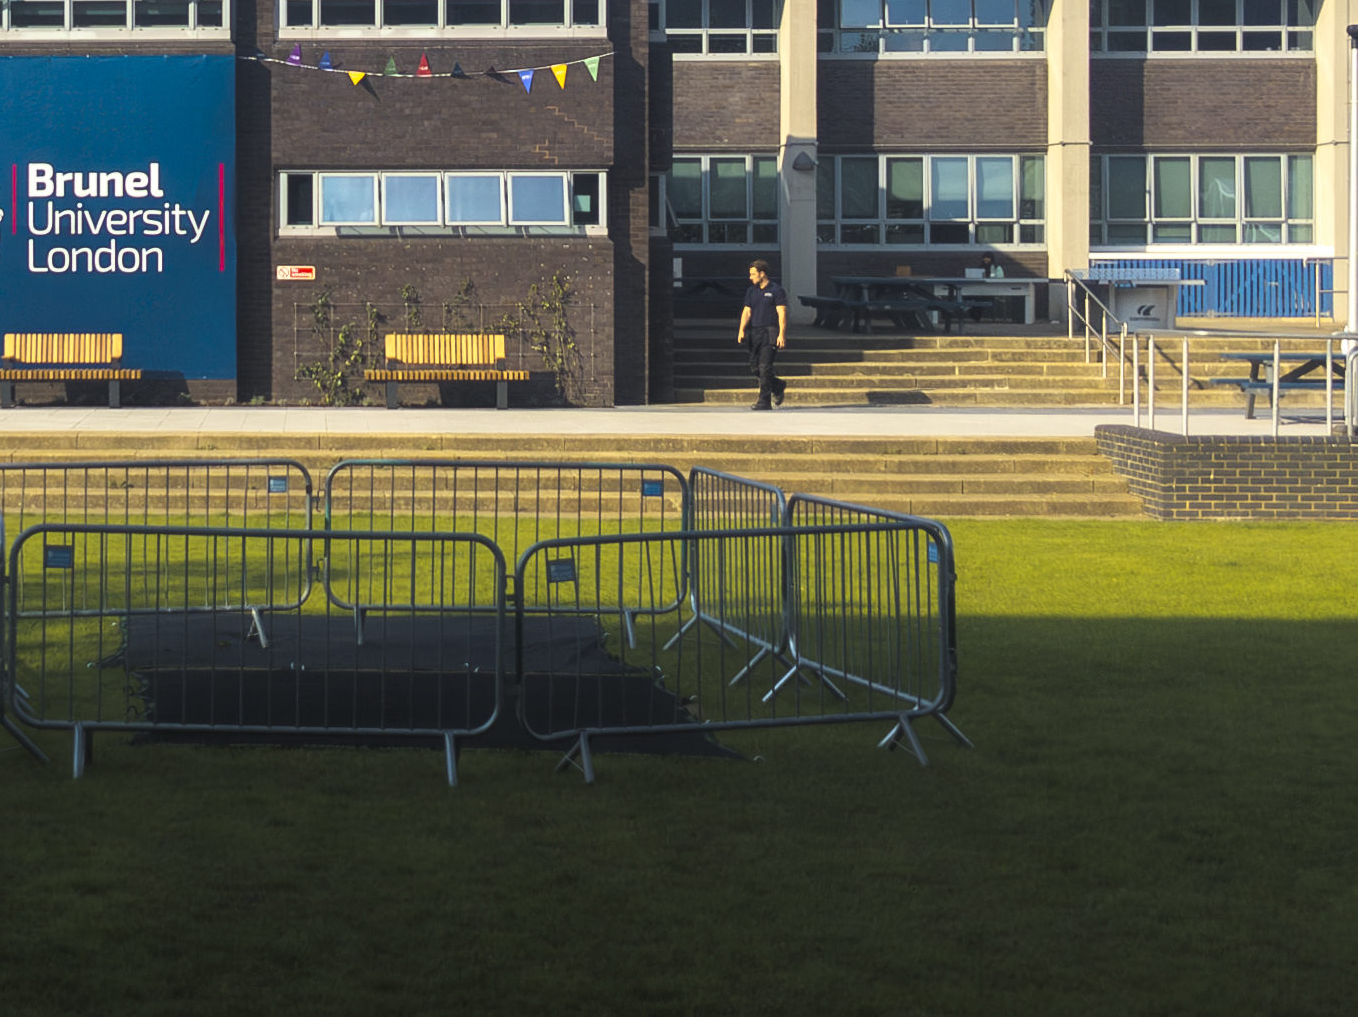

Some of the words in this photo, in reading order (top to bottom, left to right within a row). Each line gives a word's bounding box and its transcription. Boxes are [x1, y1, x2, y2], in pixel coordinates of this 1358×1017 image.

[28, 162, 164, 198] Brunel
[28, 201, 210, 244] University
[28, 239, 163, 273] London
